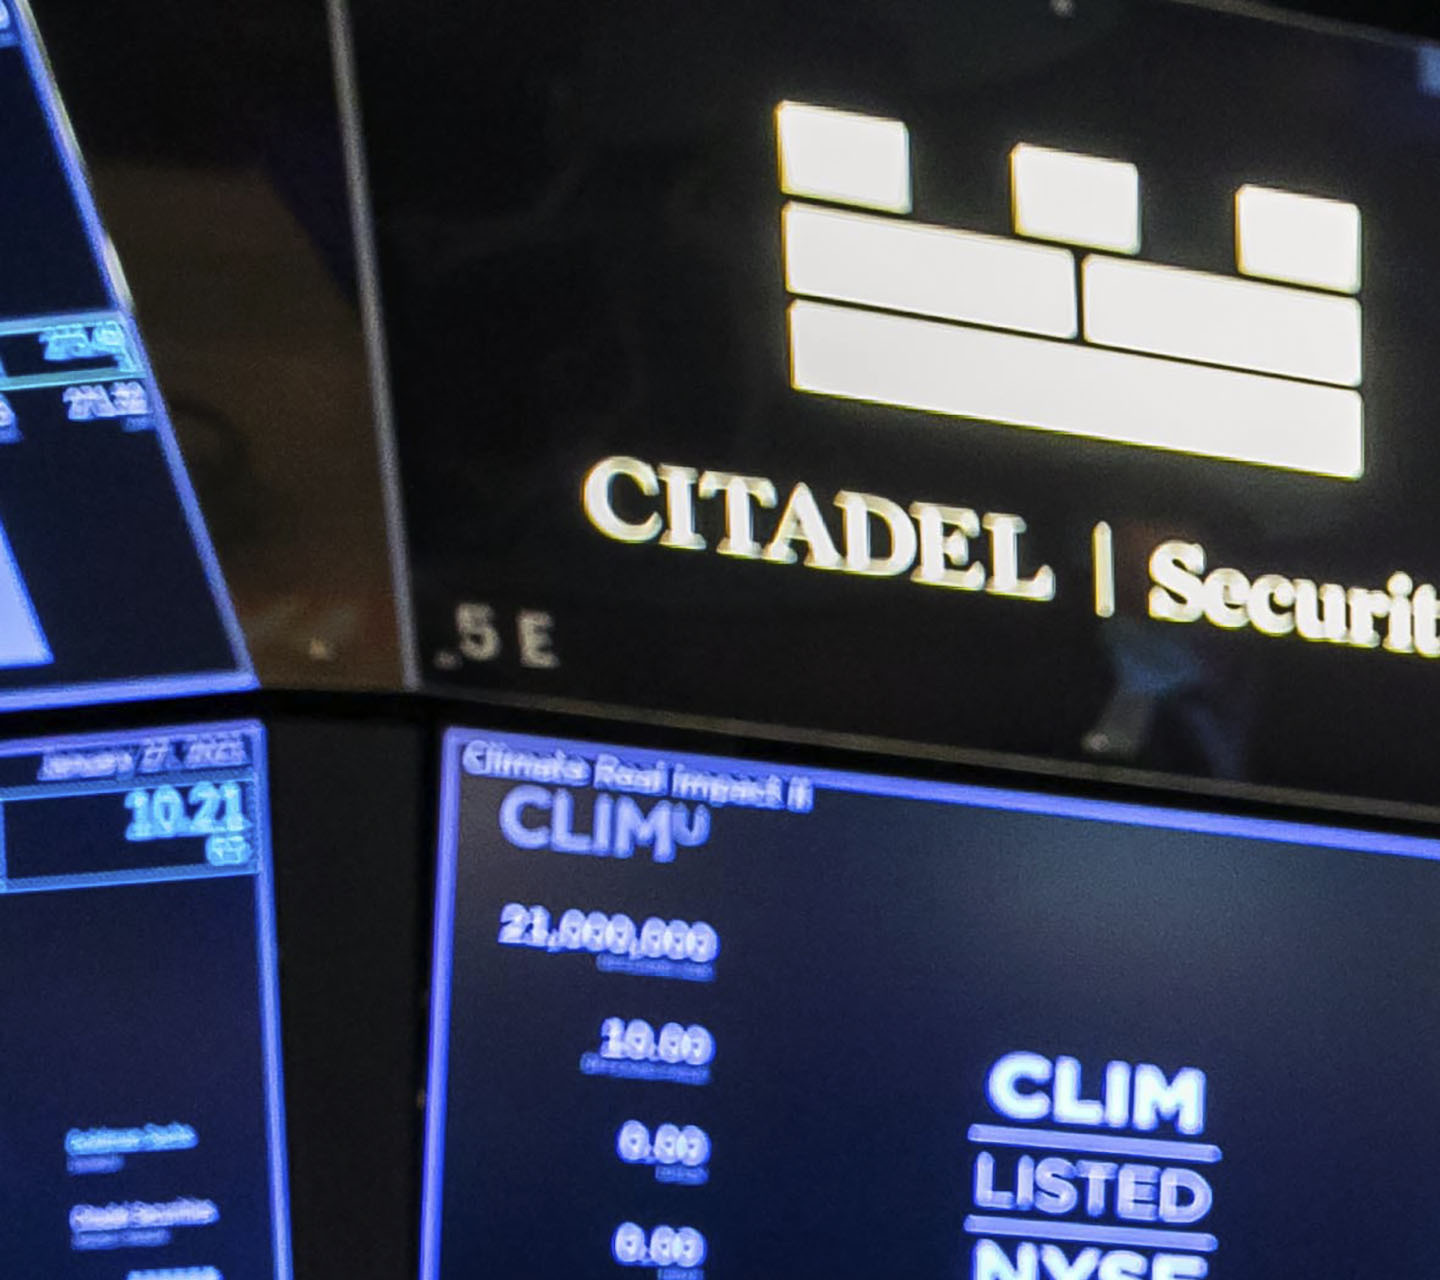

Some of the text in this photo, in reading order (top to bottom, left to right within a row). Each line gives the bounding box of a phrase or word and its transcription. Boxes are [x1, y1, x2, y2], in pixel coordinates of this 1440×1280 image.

[585, 456, 1054, 601] CITADEL
[516, 609, 560, 669] E
[498, 902, 720, 963] 21,000,000
[600, 1016, 717, 1066] 10.00
[986, 1051, 1207, 1136] CLIM
[616, 1119, 711, 1167] 0.00
[973, 1150, 1215, 1225] LISTED
[611, 1221, 706, 1268] 0.00
